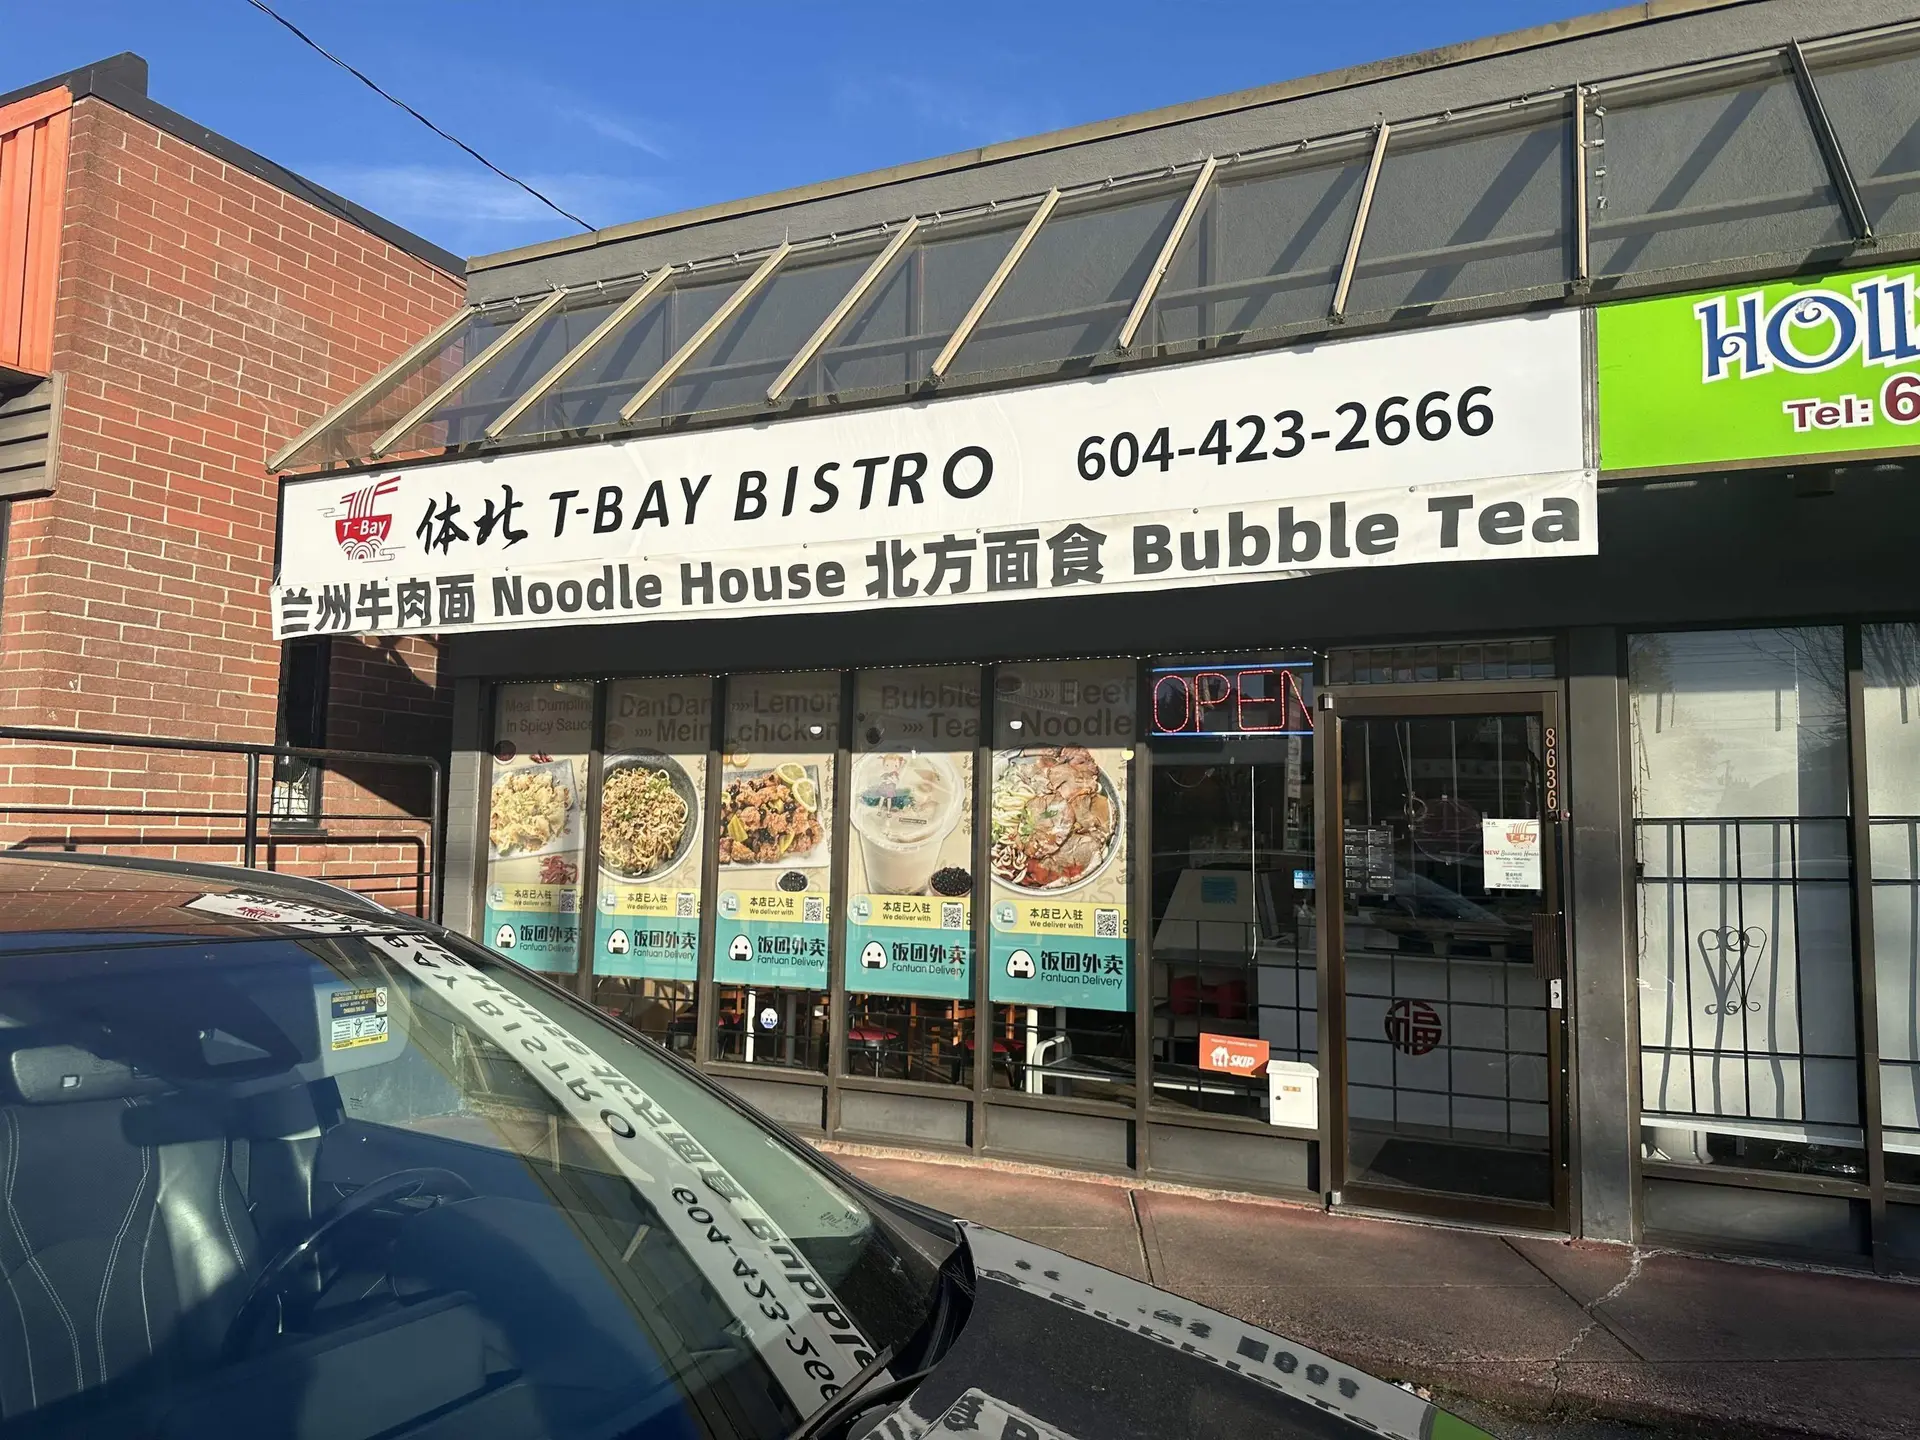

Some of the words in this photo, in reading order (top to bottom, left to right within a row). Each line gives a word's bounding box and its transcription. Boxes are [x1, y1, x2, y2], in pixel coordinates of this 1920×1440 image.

[1787, 398, 1869, 428] Tel:
[1076, 385, 1495, 482] 604-423-2666
[548, 474, 713, 538] T-BAY
[733, 445, 994, 521] BISTRO
[416, 484, 528, 555] 体北
[279, 574, 477, 635] 兰州牛肉面
[492, 564, 663, 617] Noodle
[680, 558, 846, 606] House
[866, 523, 1108, 600] 北方面食
[1132, 500, 1400, 576] Bubble
[1428, 494, 1580, 550] Tea
[882, 682, 981, 709] Bubble
[1060, 676, 1136, 705] Beef
[519, 718, 554, 735] Spicy
[927, 712, 982, 738] Tea
[1020, 707, 1132, 738] Noodle
[1545, 728, 1557, 809] 8636
[883, 901, 932, 914] 本店已入驻
[883, 913, 893, 921] We
[895, 913, 915, 922] deliver
[1029, 907, 1083, 921] 本店已入驻
[520, 925, 578, 943] 饭团外卖
[1030, 920, 1041, 928] We
[1042, 920, 1067, 929] deliver
[1068, 921, 1084, 930] with
[633, 929, 697, 949] 饭团外卖
[757, 935, 826, 956] 饭团外卖
[633, 949, 663, 958] Fantuan
[664, 951, 695, 961] Delivery
[757, 955, 790, 965] Fantuan
[791, 956, 825, 968] Delivery
[892, 942, 967, 965] 饭团外卖
[1041, 950, 1124, 975] 饭团外卖
[892, 962, 927, 974] Fantuan
[929, 964, 965, 978] Delivery
[1041, 972, 1080, 984] Fantuan
[1082, 974, 1123, 989] Delivery
[1229, 1053, 1256, 1068] SKIP
